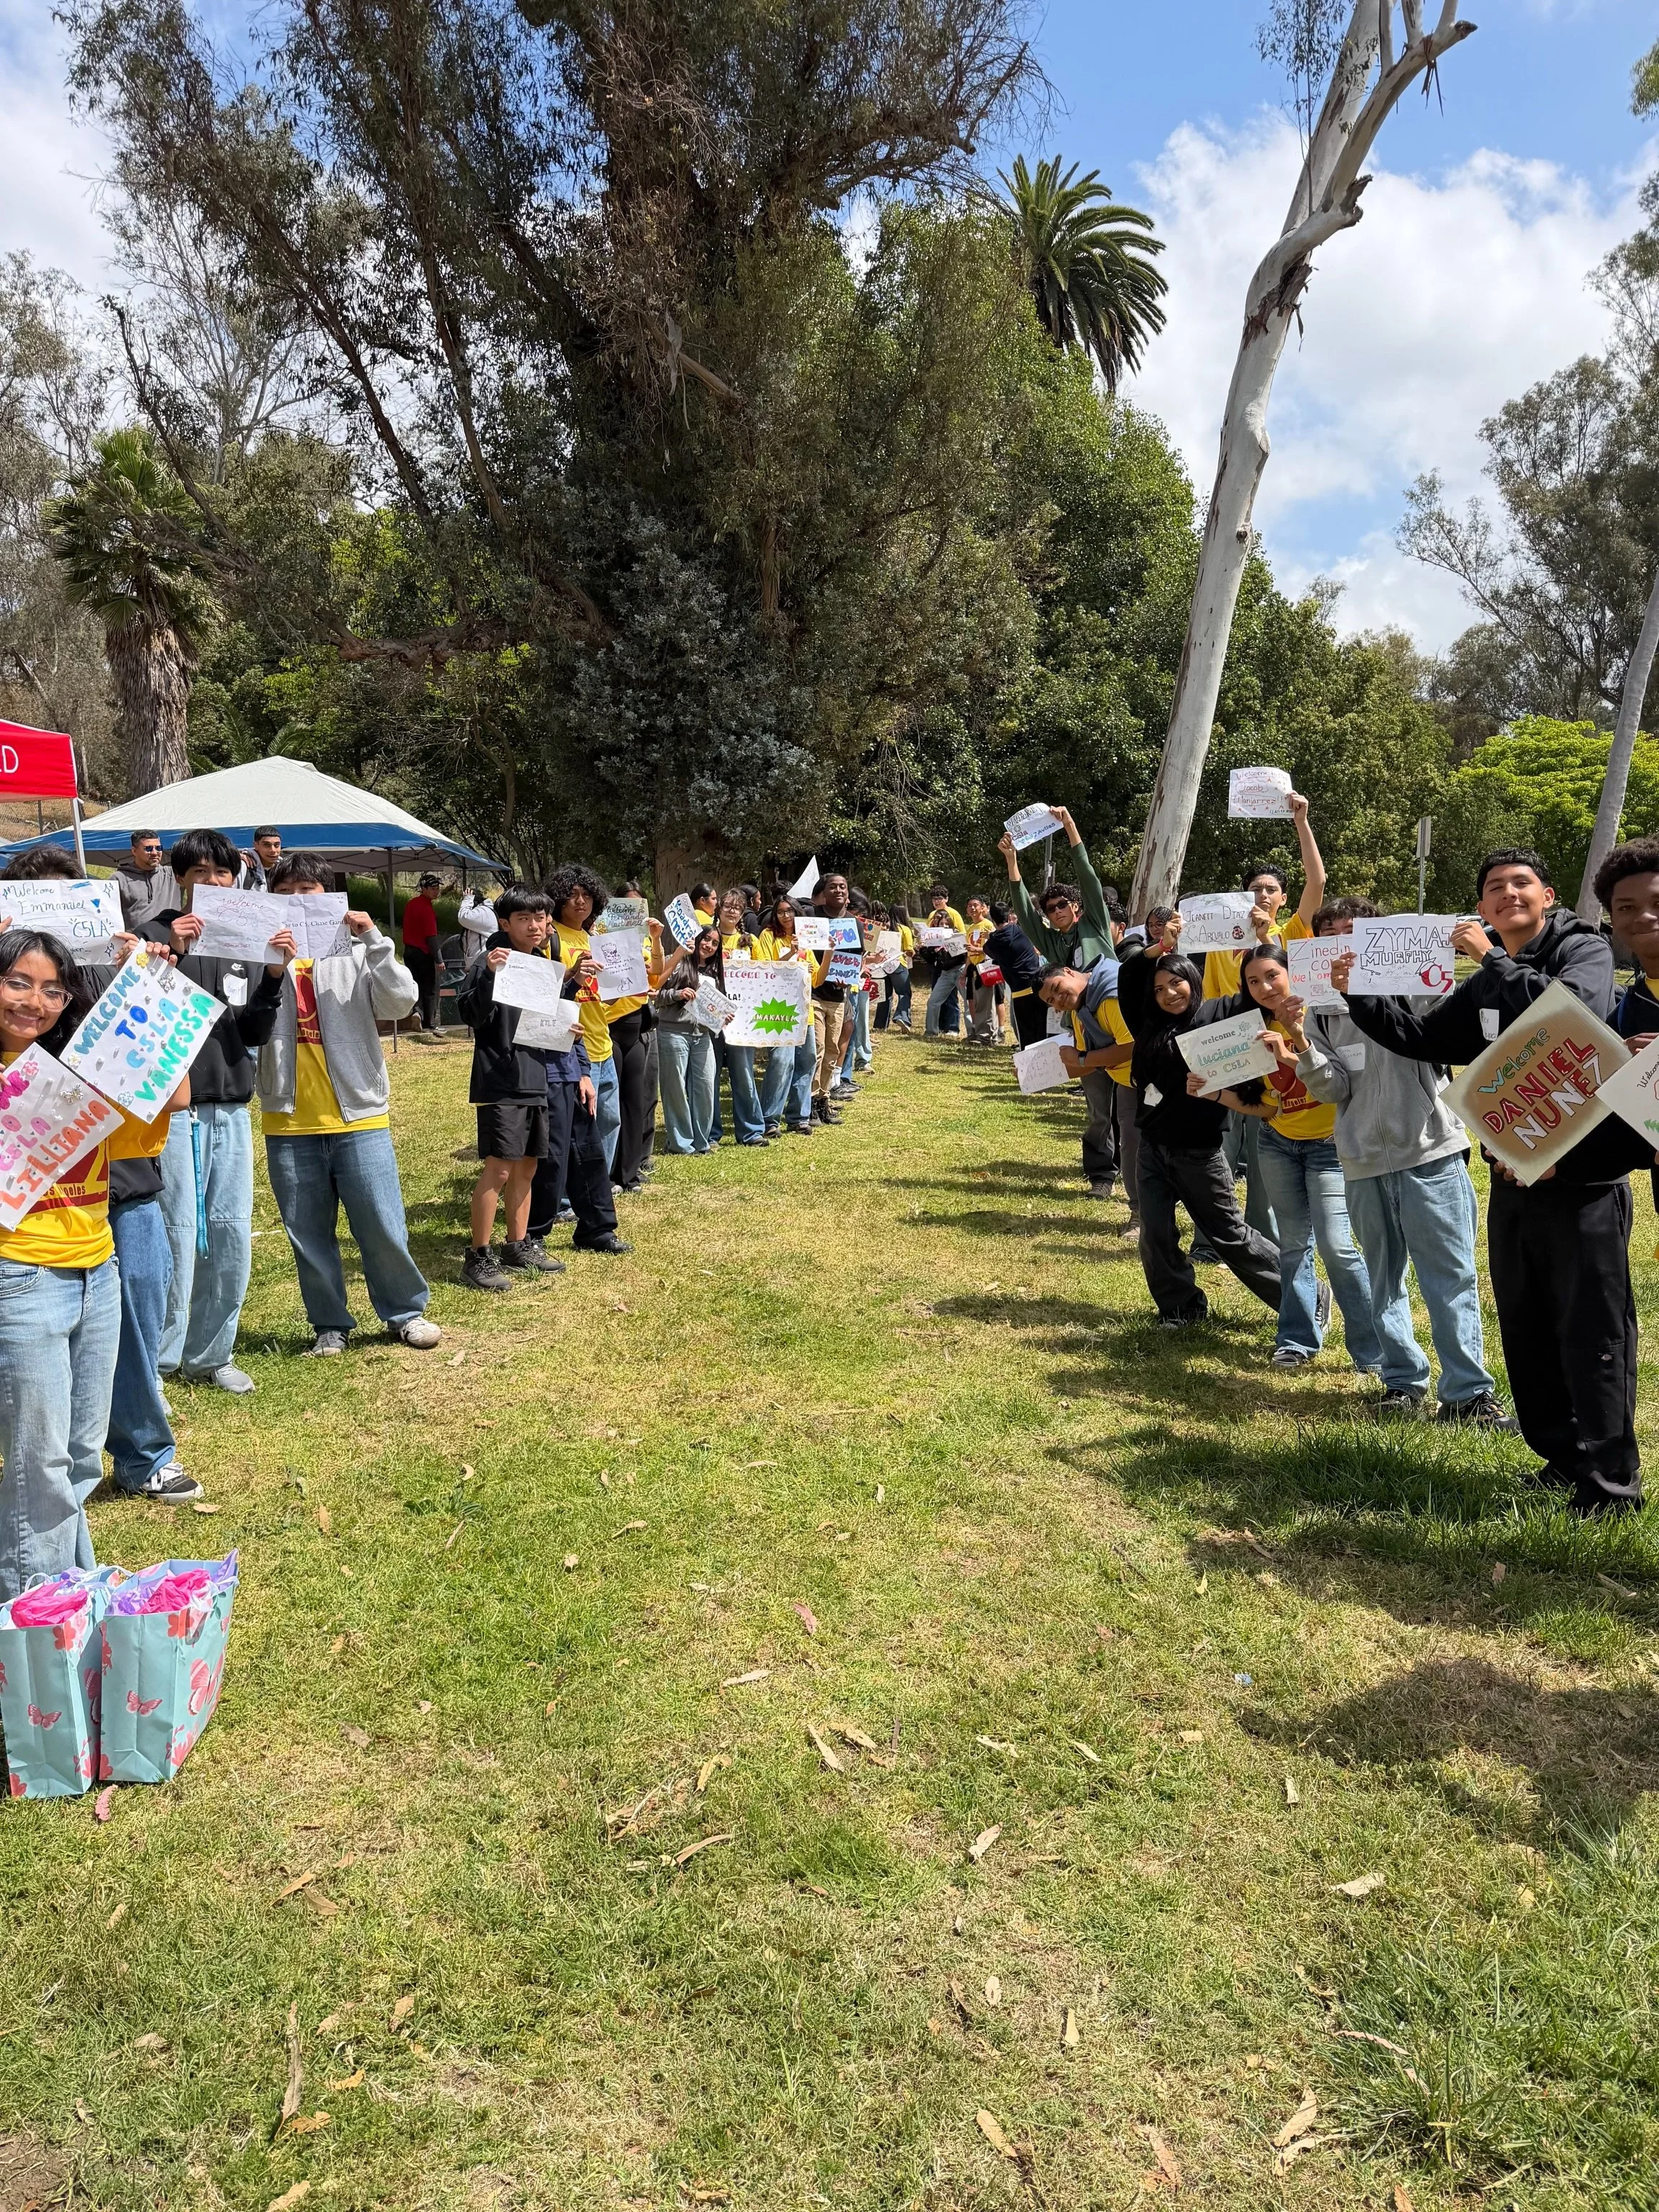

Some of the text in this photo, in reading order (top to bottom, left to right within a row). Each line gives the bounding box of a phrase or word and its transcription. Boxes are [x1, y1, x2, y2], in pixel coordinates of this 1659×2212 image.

[0, 745, 19, 773] D
[1240, 783, 1263, 792] Jacob
[10, 882, 55, 898] Welcome
[1360, 950, 1432, 967] MURPHY
[73, 966, 140, 1054] WELCOME
[114, 1005, 148, 1040] TO
[755, 1013, 796, 1022] MAKAYLA
[134, 992, 215, 1101] VANESSA
[1200, 1030, 1236, 1046] welcome
[1207, 1069, 1217, 1078] to
[1478, 1028, 1550, 1094] Welcome
[1637, 1054, 1659, 1089] Welcom
[1482, 1038, 1596, 1134] DANIEL
